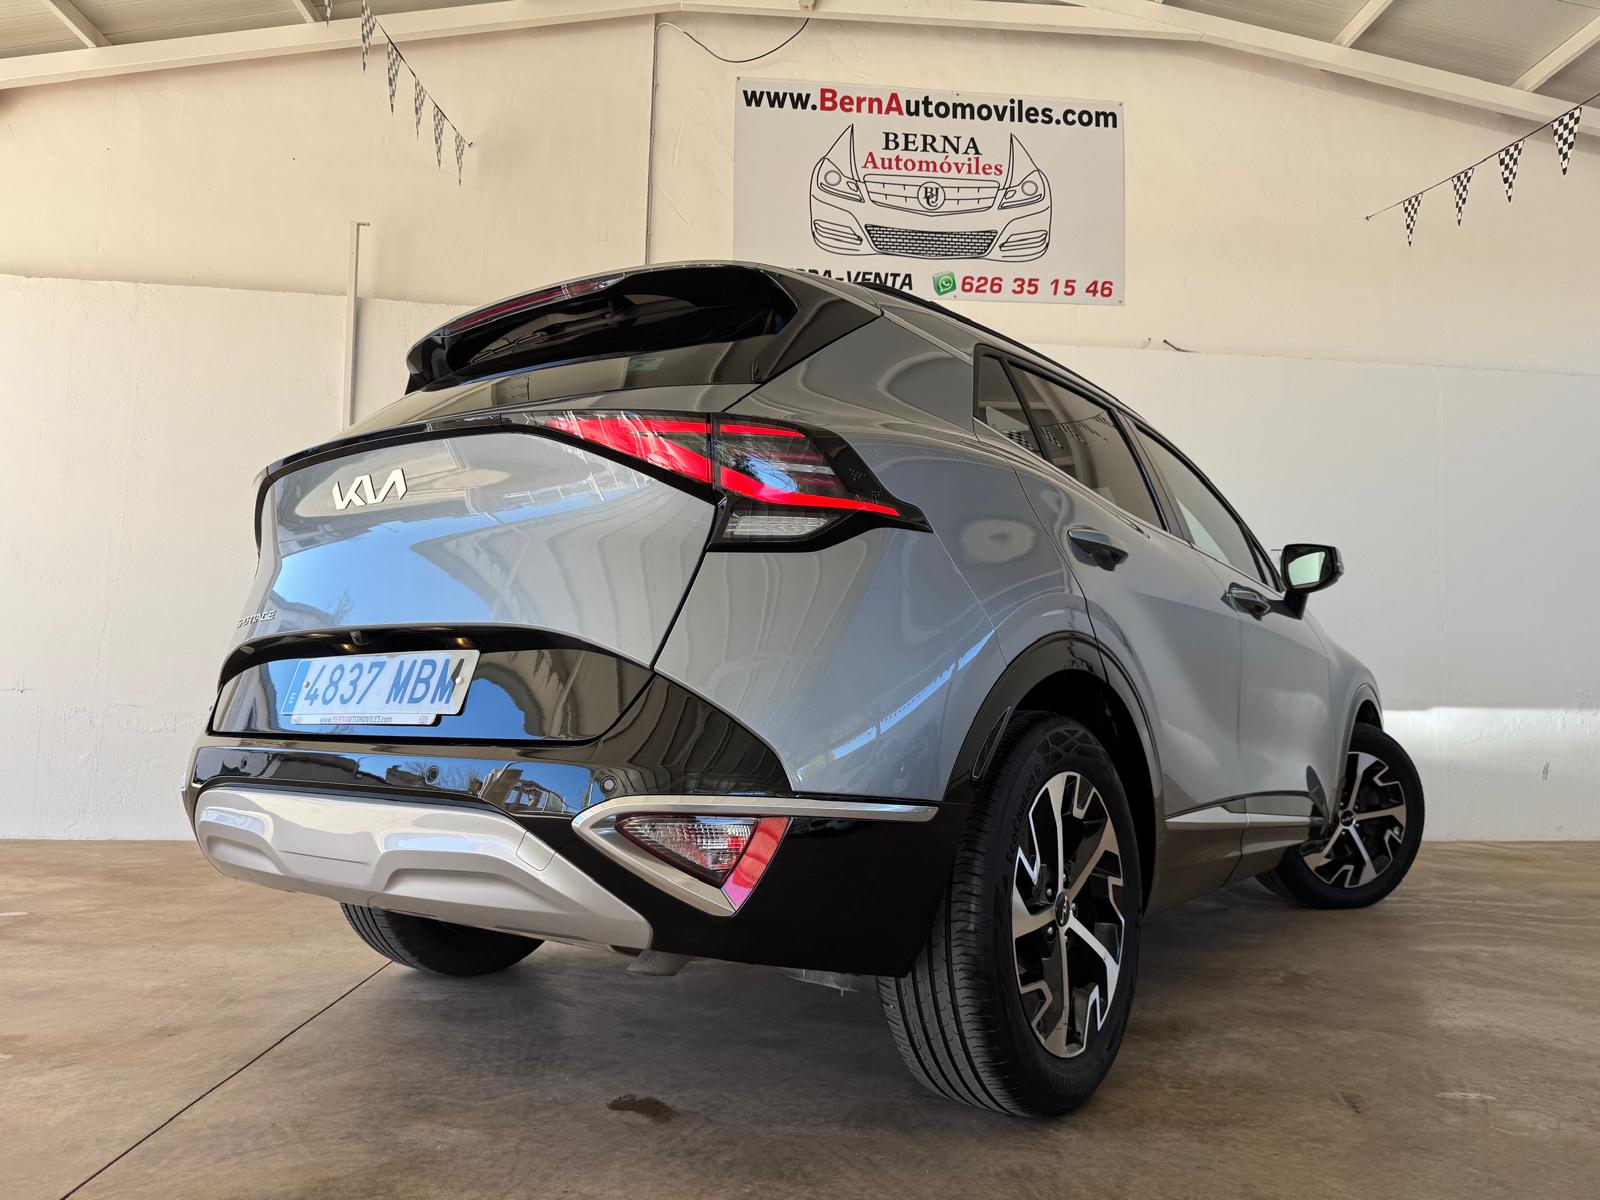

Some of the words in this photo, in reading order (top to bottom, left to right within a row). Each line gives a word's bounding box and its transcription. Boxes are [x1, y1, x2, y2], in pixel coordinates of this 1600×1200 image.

[743, 88, 1118, 128] www.BernAutomoviles.com
[882, 132, 982, 156] BERNA
[861, 151, 1003, 176] Automóviles
[961, 276, 1002, 293] 626
[1012, 277, 1039, 295] 35
[1051, 278, 1077, 296] 15
[1085, 280, 1113, 297] 46
[304, 661, 386, 706] 4837
[385, 658, 464, 705] MBM
